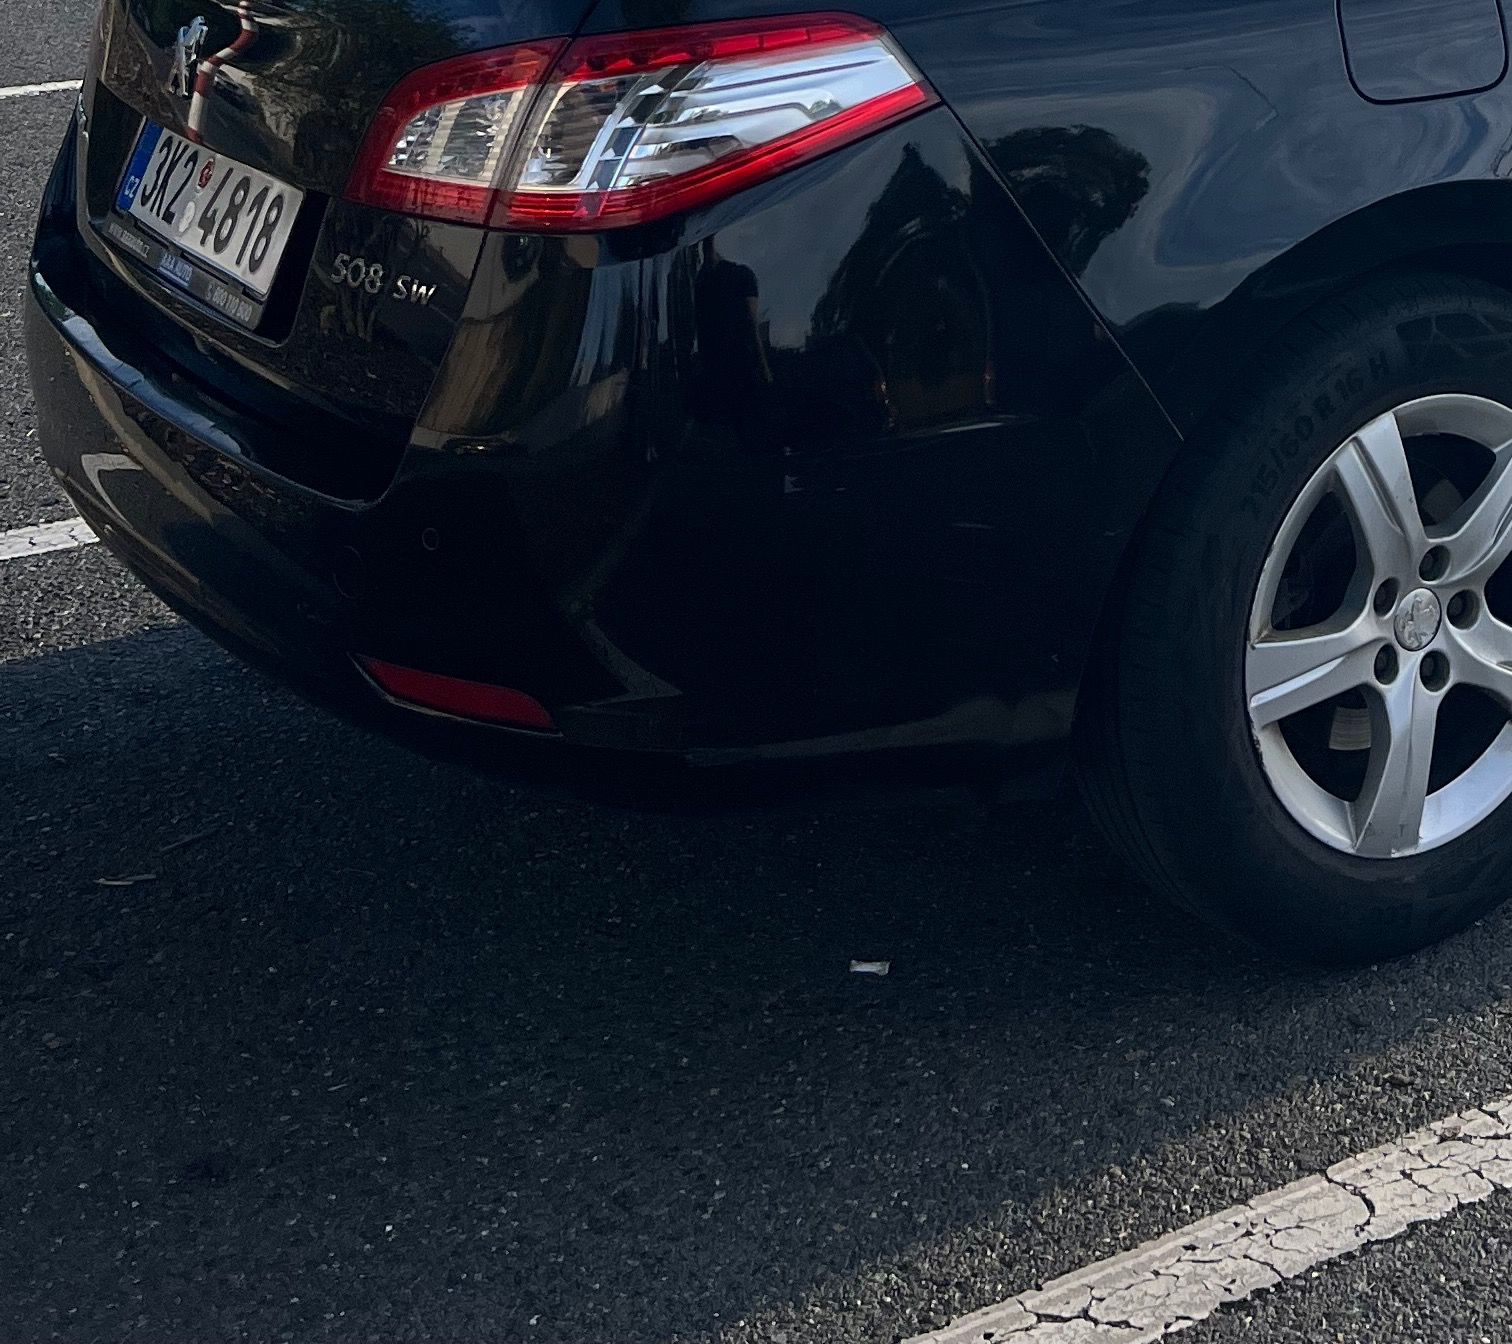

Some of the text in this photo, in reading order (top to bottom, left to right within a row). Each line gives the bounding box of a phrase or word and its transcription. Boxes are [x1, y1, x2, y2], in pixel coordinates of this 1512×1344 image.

[124, 175, 141, 199] CZ
[140, 135, 284, 274] 3K2 4818
[329, 252, 438, 305] 508 SW
